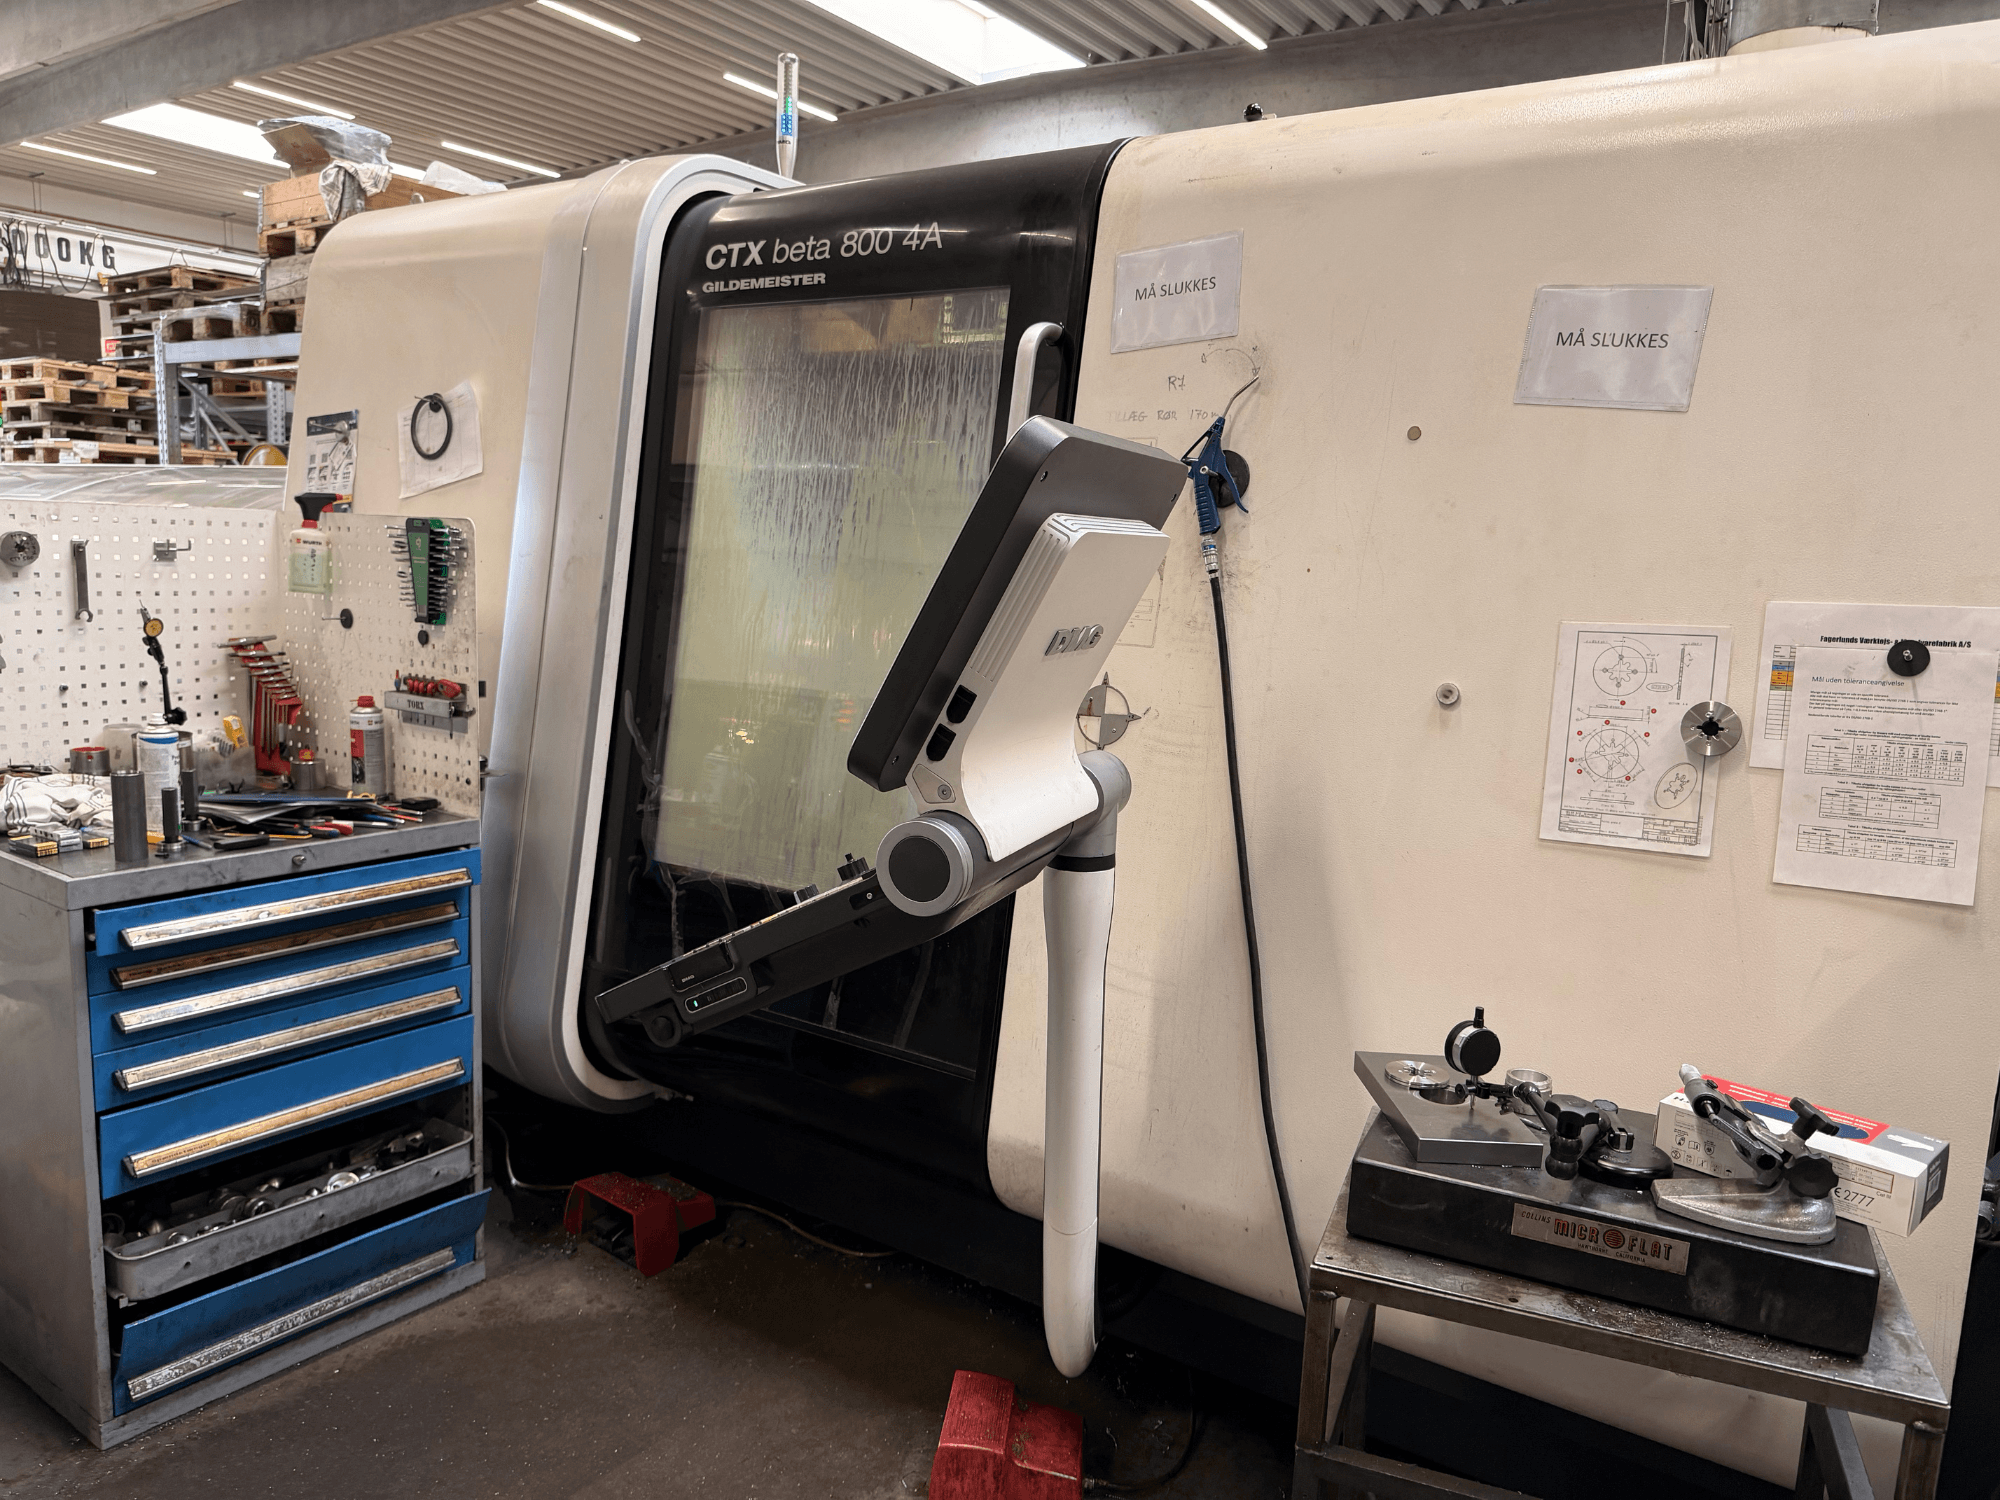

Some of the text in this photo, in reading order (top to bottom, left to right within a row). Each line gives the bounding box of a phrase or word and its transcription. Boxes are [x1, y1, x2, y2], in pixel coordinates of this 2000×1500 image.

[705, 221, 943, 270] CTX beta 800 4A
[702, 272, 826, 294] GILDEMEISTER
[1135, 276, 1217, 301] MÅ SLUKKES
[1555, 327, 1670, 349] MÅ SLUKKES
[1045, 623, 1104, 656] DMG
[1820, 635, 1859, 645] Fagerlunds
[1958, 640, 1972, 649] A/S
[1811, 675, 1824, 683] Mål
[1843, 677, 1905, 688] toleranceangivelse
[406, 699, 424, 710] TORX
[1843, 1189, 1875, 1207] 2777
[1521, 1210, 1552, 1224] COLLINS
